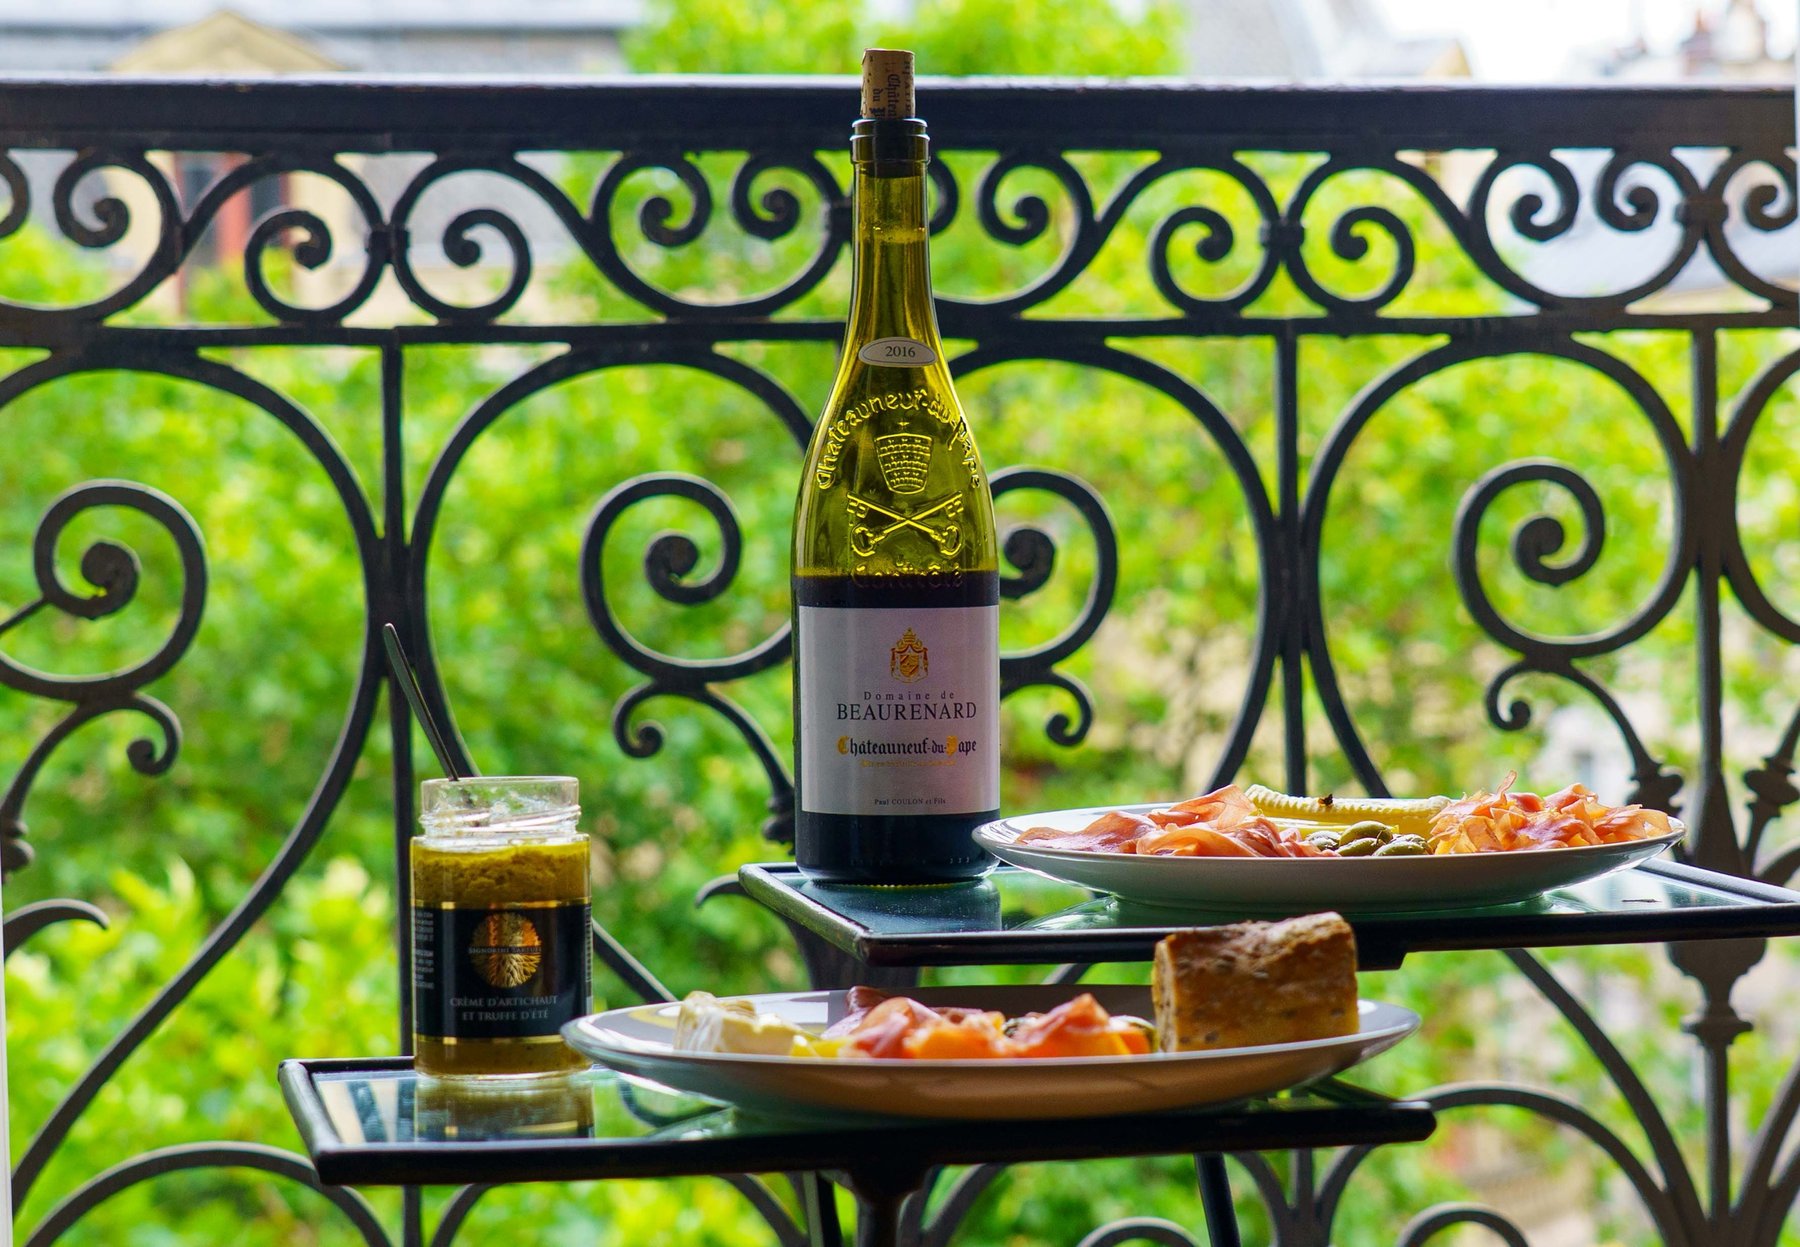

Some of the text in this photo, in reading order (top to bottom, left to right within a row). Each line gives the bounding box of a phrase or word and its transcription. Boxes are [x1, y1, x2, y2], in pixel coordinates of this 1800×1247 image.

[885, 346, 916, 358] 2016
[864, 690, 955, 700] Domaine de
[837, 702, 977, 721] BEAURENARD
[934, 797, 946, 805] Fils
[450, 995, 558, 1007] CRÈME D'ARTICHAUT
[462, 1007, 549, 1021] ET TRUFFE D'ÉTÉ
